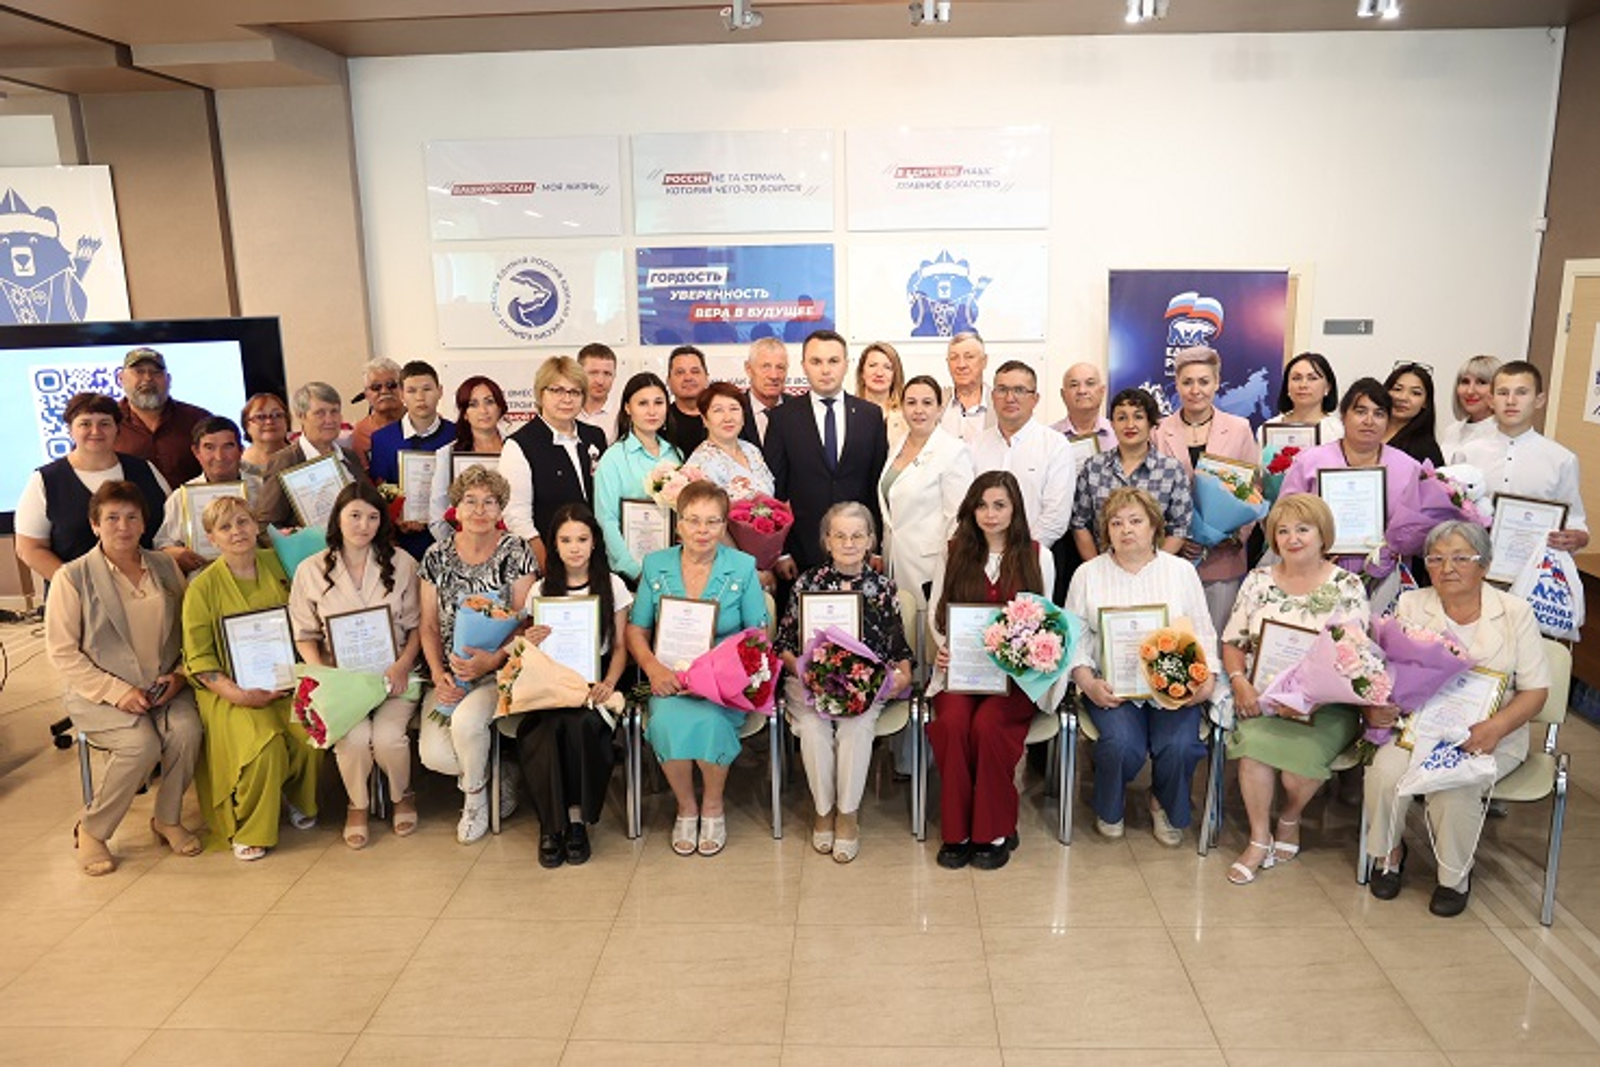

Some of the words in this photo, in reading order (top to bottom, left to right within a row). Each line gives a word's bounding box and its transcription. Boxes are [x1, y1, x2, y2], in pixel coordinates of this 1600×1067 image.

[665, 175, 708, 183] РОССИЯ
[711, 174, 726, 182] НЕ
[666, 186, 713, 194] КОТОРАЯ
[715, 185, 758, 194] ЧЕГО-ТО
[760, 184, 801, 193] БОИТСЯ
[650, 271, 722, 284] ГОРДОСТЬ
[669, 288, 770, 300] УВЕРЕННОСТЬ
[694, 307, 731, 318] ВЕРА
[735, 307, 744, 317] В
[747, 306, 815, 319] БУДУЩЕЕ
[1357, 321, 1366, 333] 4
